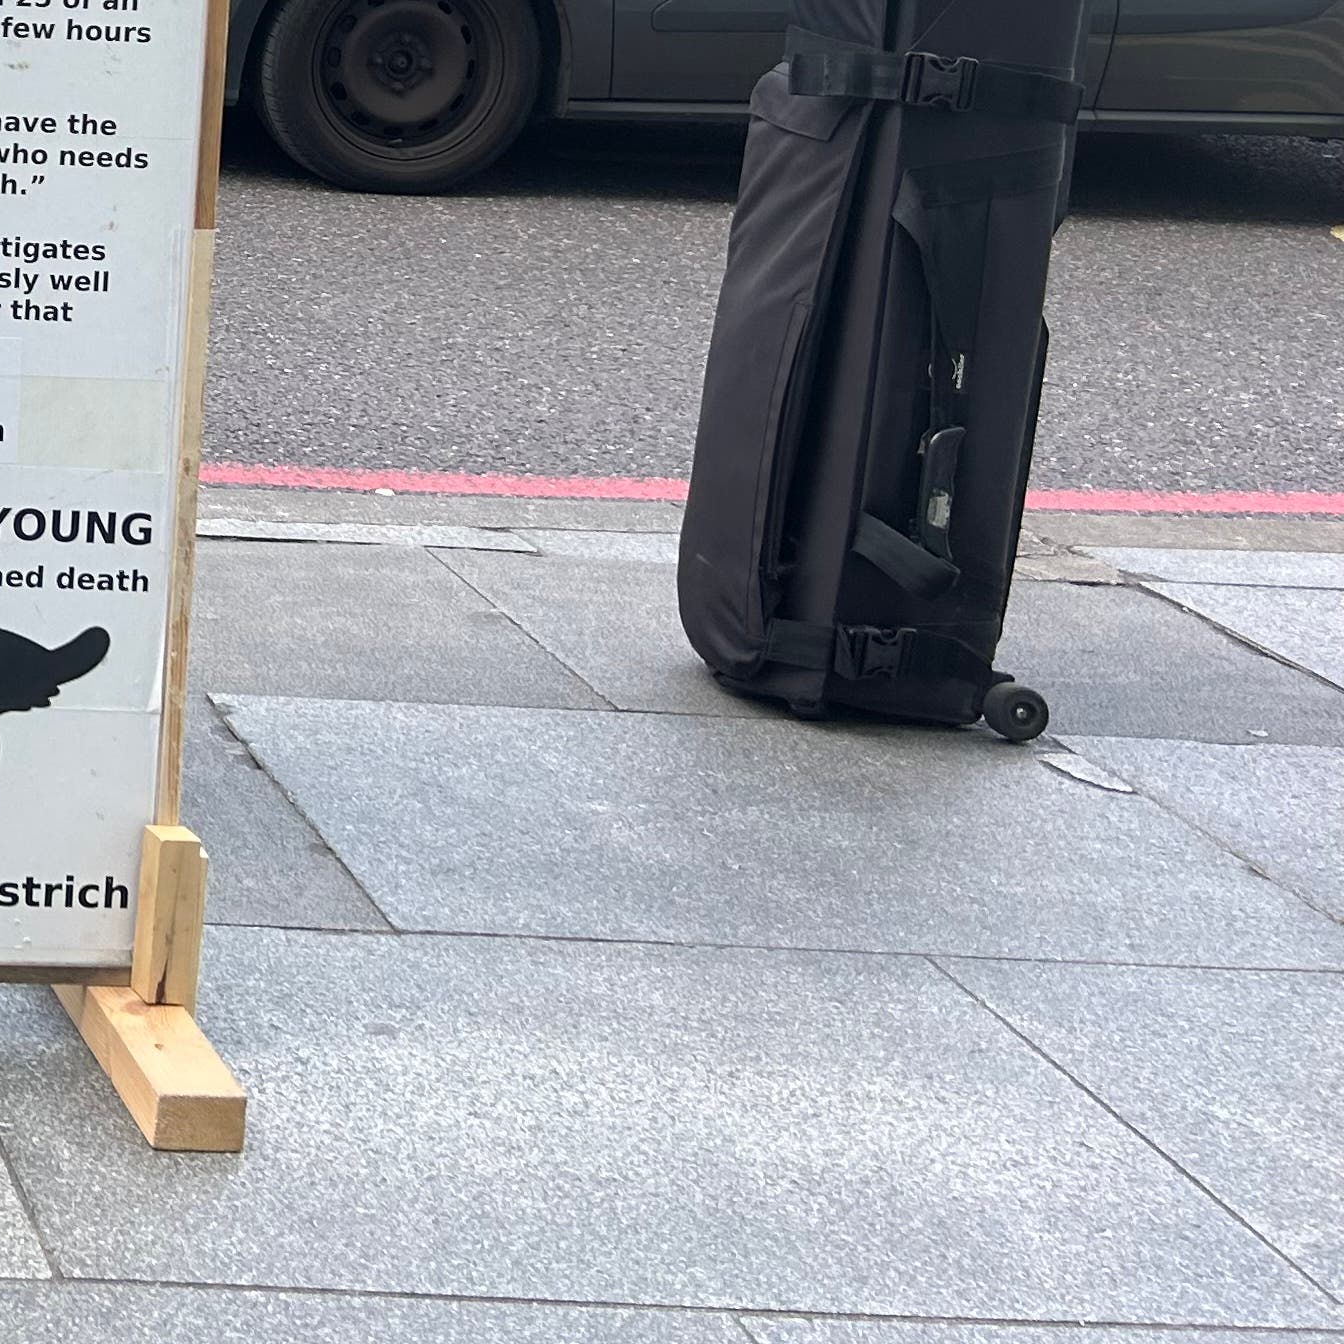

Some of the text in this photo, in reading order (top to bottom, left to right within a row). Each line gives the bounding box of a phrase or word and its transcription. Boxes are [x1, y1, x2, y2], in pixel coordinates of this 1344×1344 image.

[1, 16, 56, 39] few
[66, 19, 151, 43] hours
[67, 114, 116, 135] the
[59, 147, 148, 168] needs
[50, 271, 109, 292] well
[10, 299, 73, 322] that
[56, 566, 148, 592] death
